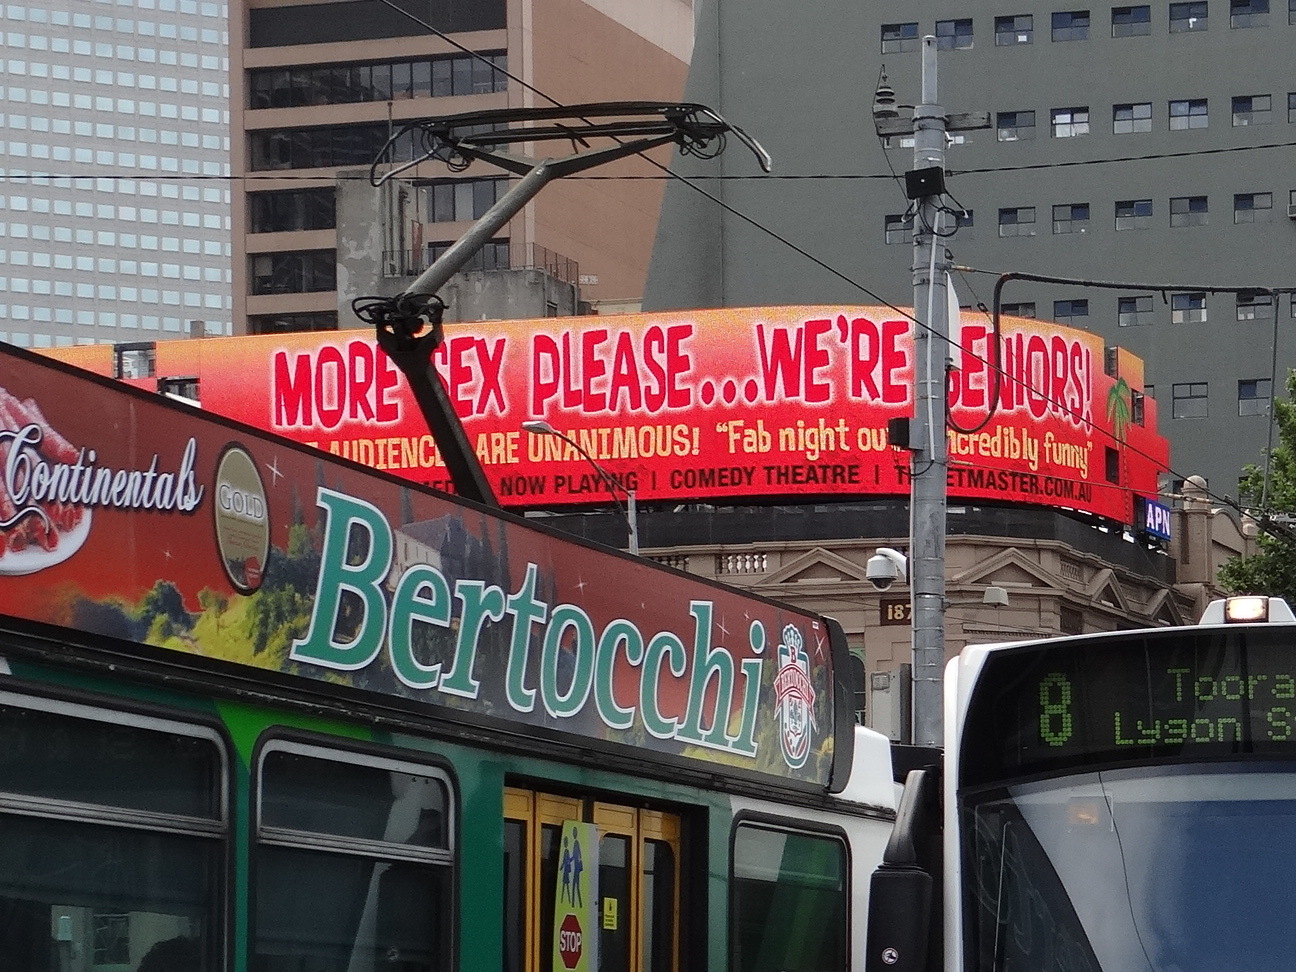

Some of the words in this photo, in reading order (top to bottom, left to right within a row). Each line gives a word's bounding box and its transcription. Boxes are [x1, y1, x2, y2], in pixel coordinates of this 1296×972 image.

[274, 340, 399, 428] MORE
[477, 432, 521, 465] ARE
[528, 423, 700, 463] UNANIMOUS!
[779, 417, 850, 461] night
[948, 425, 1039, 471] ncredibly
[0, 424, 204, 512] Continentals
[501, 476, 546, 497] NOW
[554, 471, 638, 495] PLAYING
[670, 465, 757, 490] COMEDY
[763, 463, 860, 486] THEATRE
[894, 464, 1091, 503] TIETMASTER.COM.AU
[219, 484, 264, 519] GOLD
[1146, 503, 1170, 536] APN
[290, 486, 766, 758] Bertocchi
[1038, 672, 1072, 747] 8
[1113, 711, 1242, 745] Lygon
[559, 929, 583, 953] STOP
